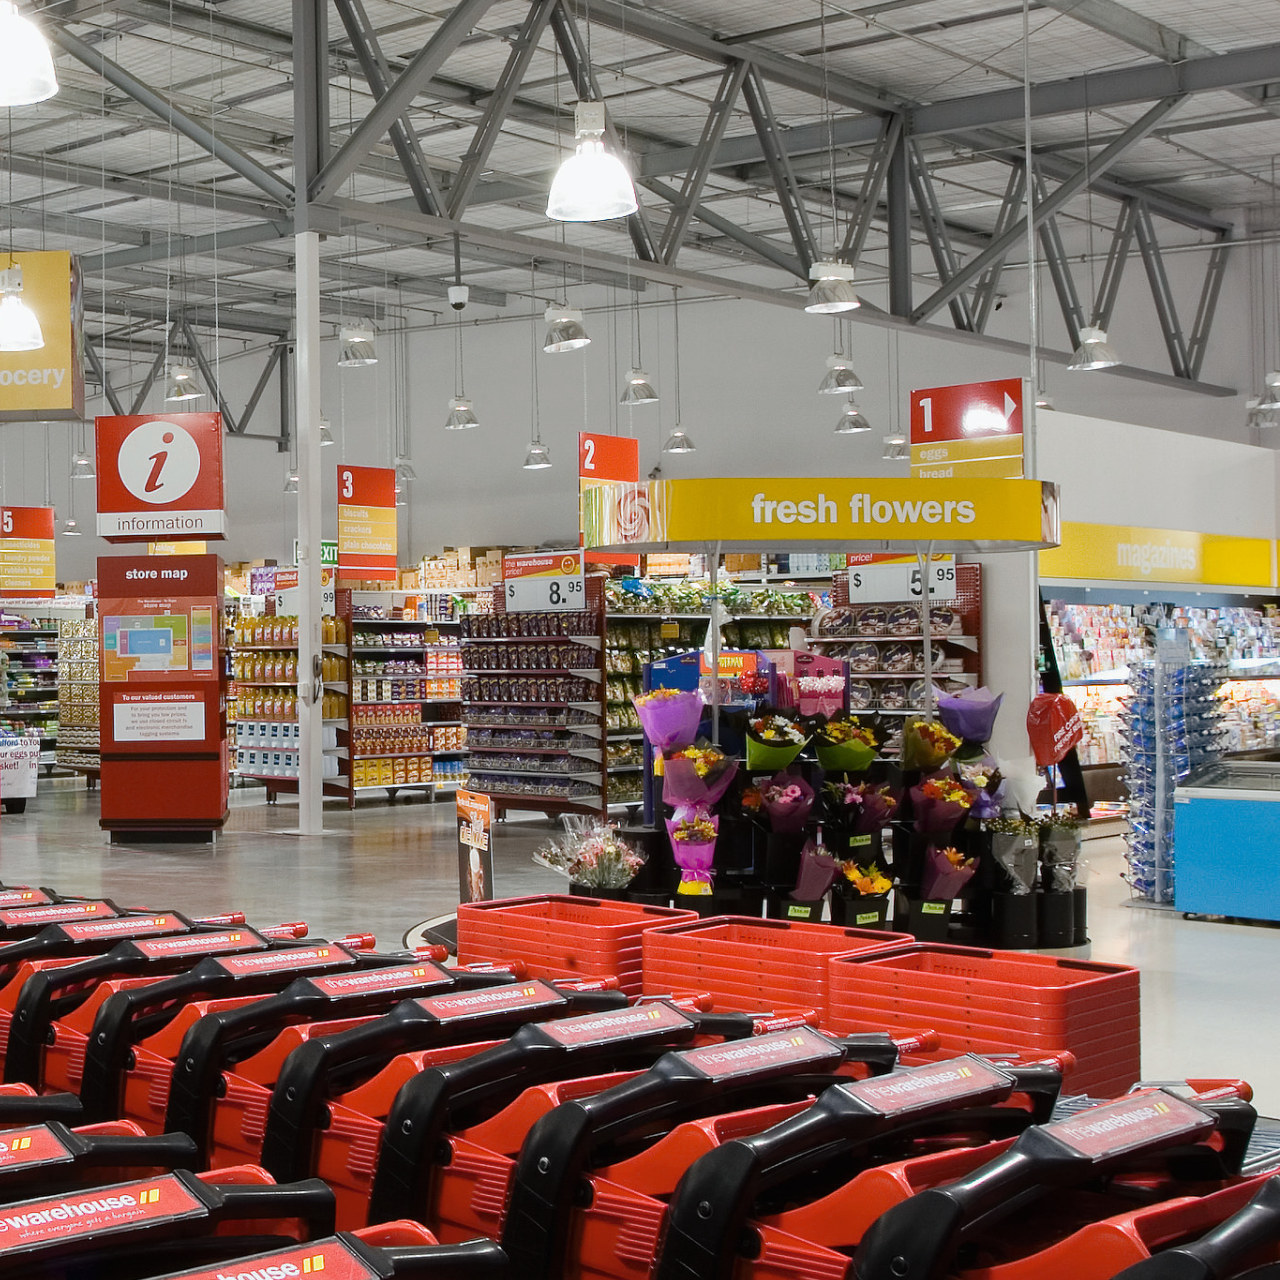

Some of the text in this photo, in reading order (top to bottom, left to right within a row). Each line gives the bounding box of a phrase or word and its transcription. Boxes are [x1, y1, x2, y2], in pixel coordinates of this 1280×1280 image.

[920, 398, 933, 432] 1
[584, 440, 595, 470] 2
[920, 447, 949, 460] eggs
[342, 471, 353, 498] 3
[343, 508, 369, 518] biscuits
[751, 493, 976, 523] fresh flowers
[3, 511, 13, 533] 5
[117, 515, 204, 531] information
[343, 525, 372, 534] crackers
[4, 540, 41, 550] insecticides
[361, 541, 393, 551] chocolate
[27, 554, 51, 564] powder
[505, 557, 553, 568] the warehouse
[850, 552, 873, 564] price!
[1117, 539, 1197, 574] magazines
[125, 568, 189, 581] store map
